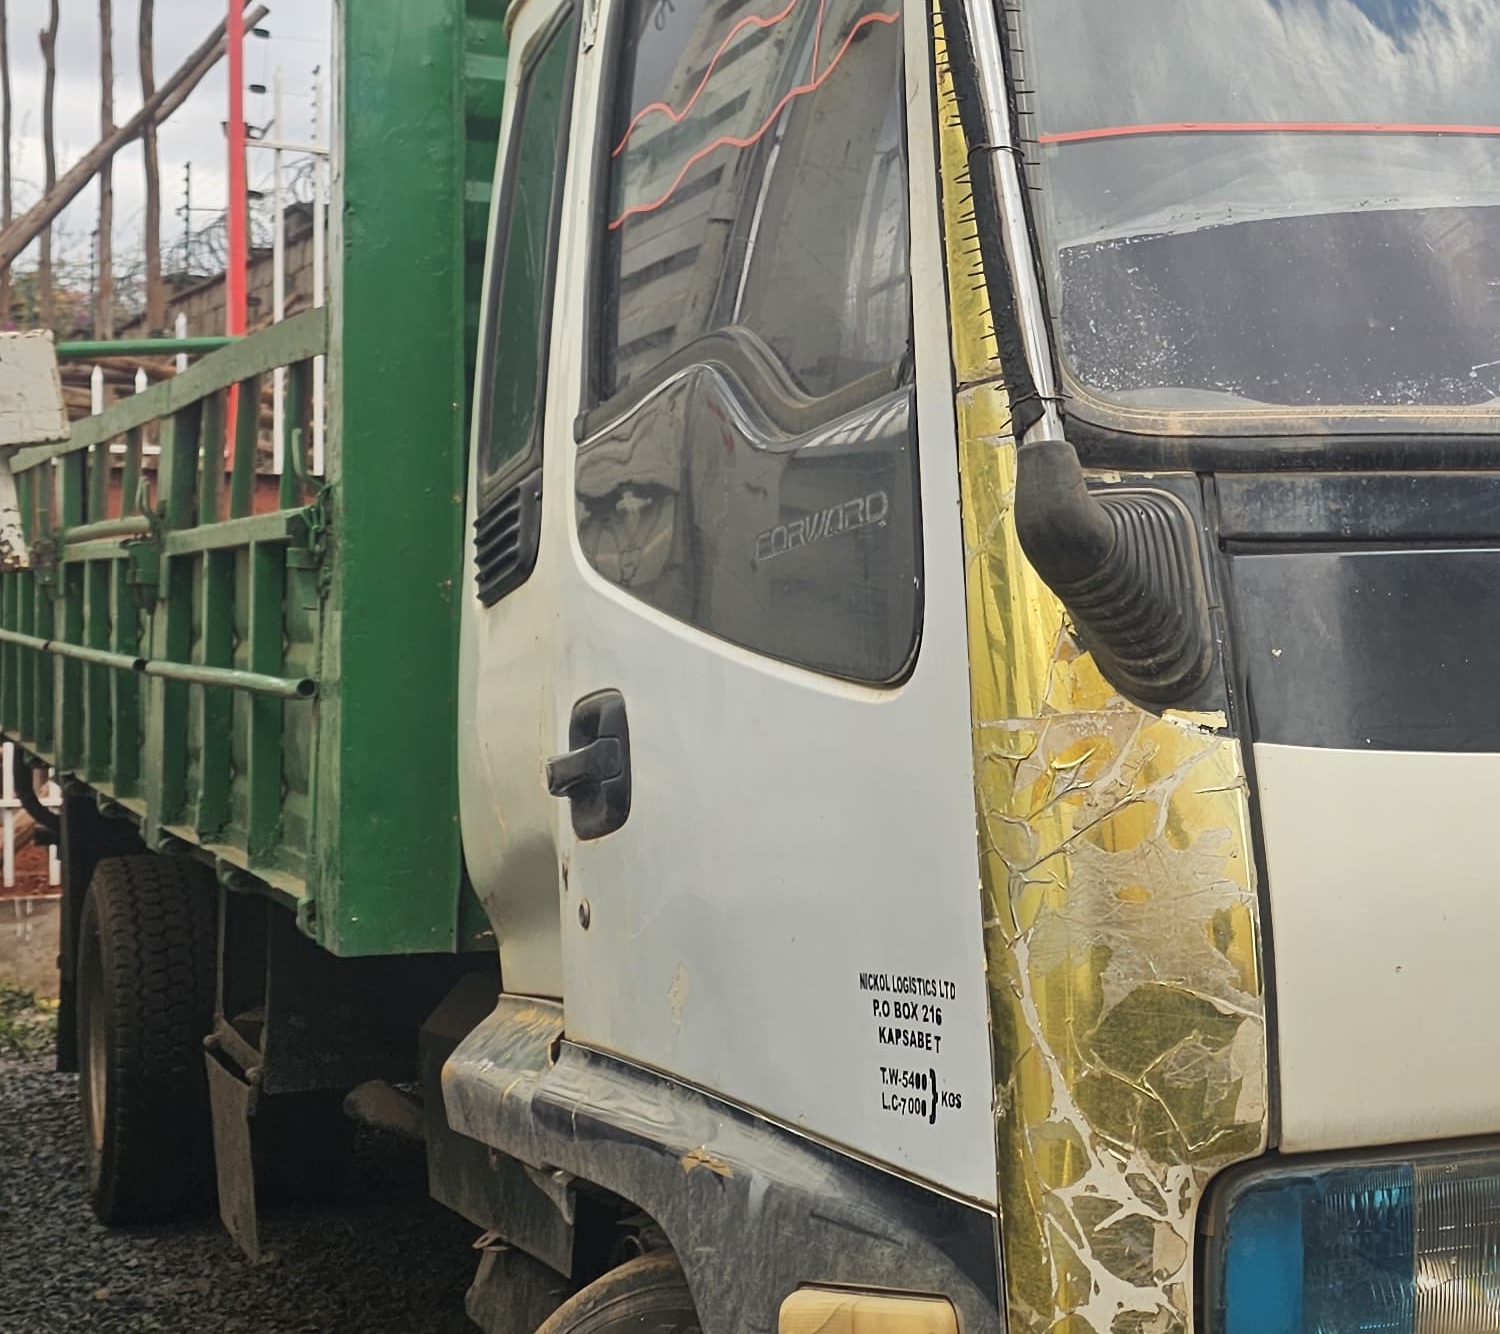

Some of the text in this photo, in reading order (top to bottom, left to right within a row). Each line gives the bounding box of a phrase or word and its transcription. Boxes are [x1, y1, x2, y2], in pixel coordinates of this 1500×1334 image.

[756, 490, 888, 561] FORWARD
[859, 972, 956, 1000] NICKOL LOGISTICS LTD
[873, 999, 942, 1026] P.O BOX 216
